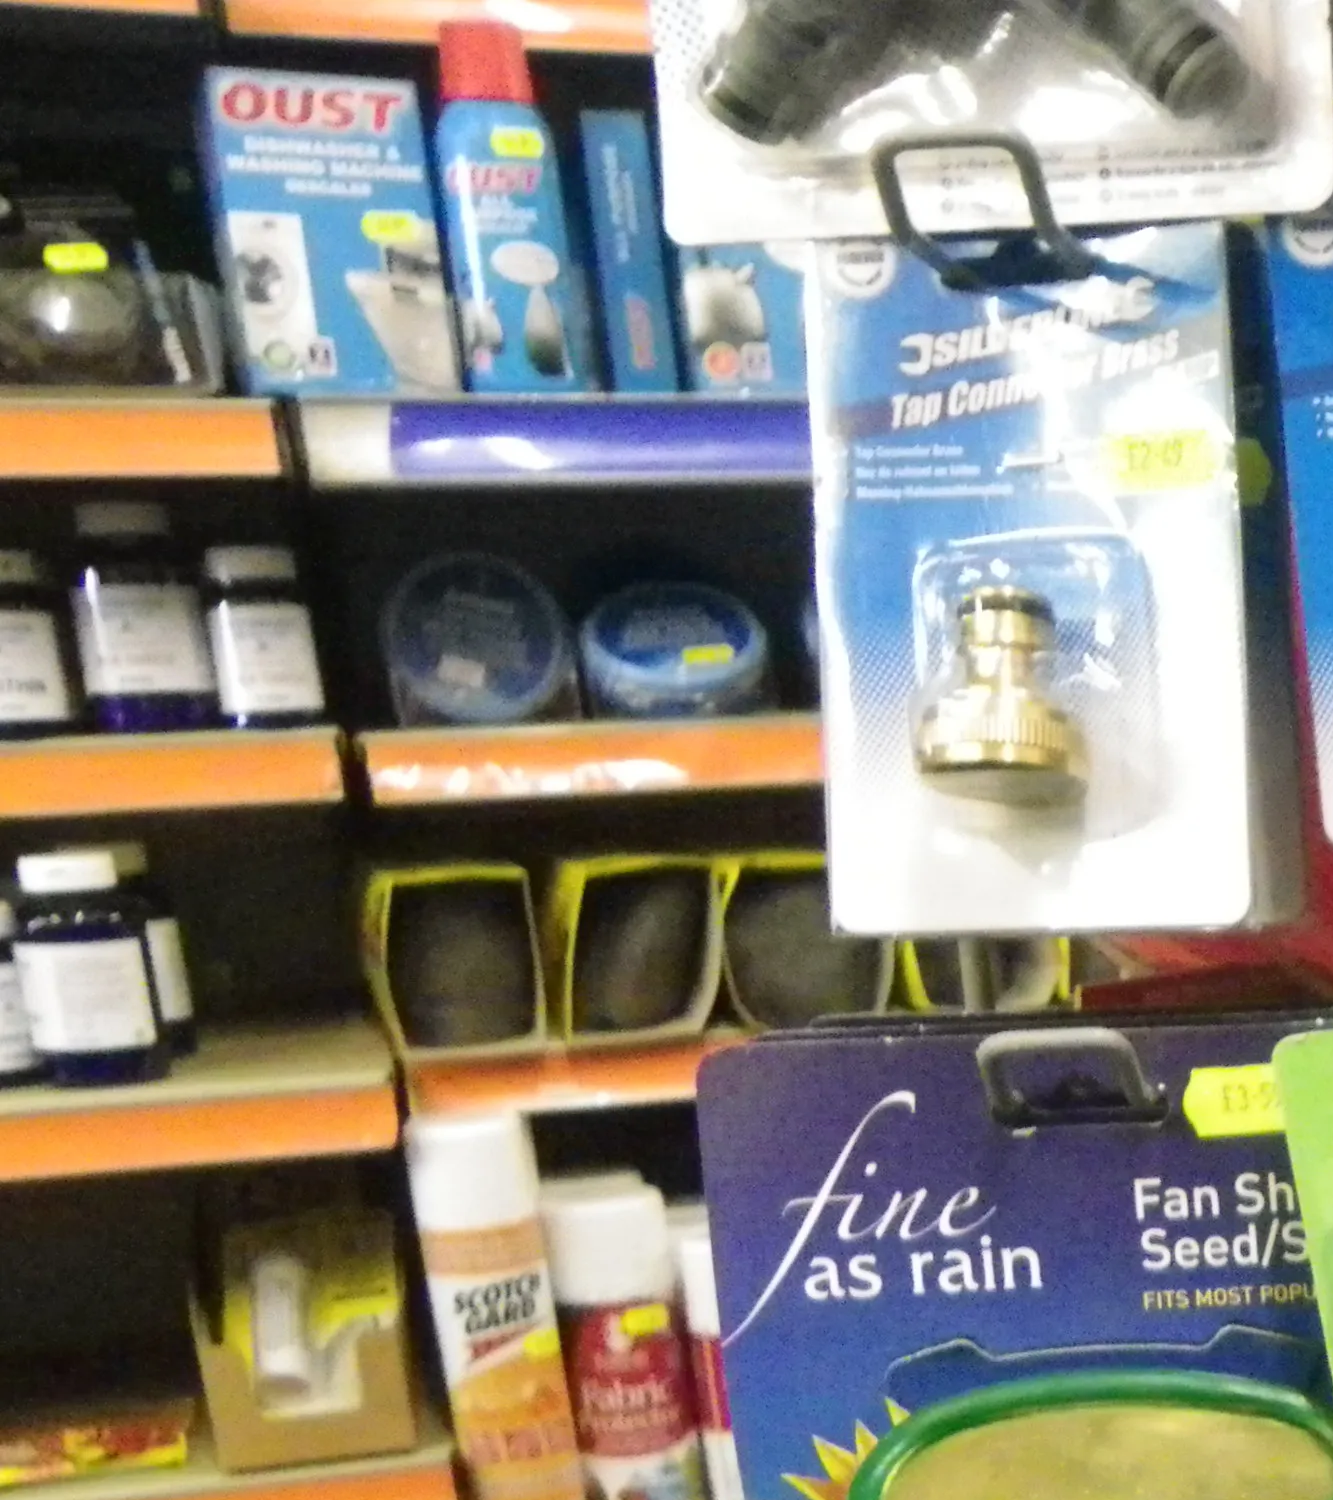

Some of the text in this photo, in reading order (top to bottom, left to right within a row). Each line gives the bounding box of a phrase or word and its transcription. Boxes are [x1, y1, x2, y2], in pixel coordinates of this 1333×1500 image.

[220, 81, 401, 134] OUST
[227, 155, 424, 183] WASHING MACHINE
[890, 391, 941, 431] Tap
[1103, 329, 1180, 378] Brass
[719, 1090, 999, 1350] fine
[1133, 1176, 1222, 1222] Fan
[802, 1233, 1045, 1302] as rain
[1143, 1289, 1190, 1311] FITS
[1195, 1286, 1253, 1309] MOST
